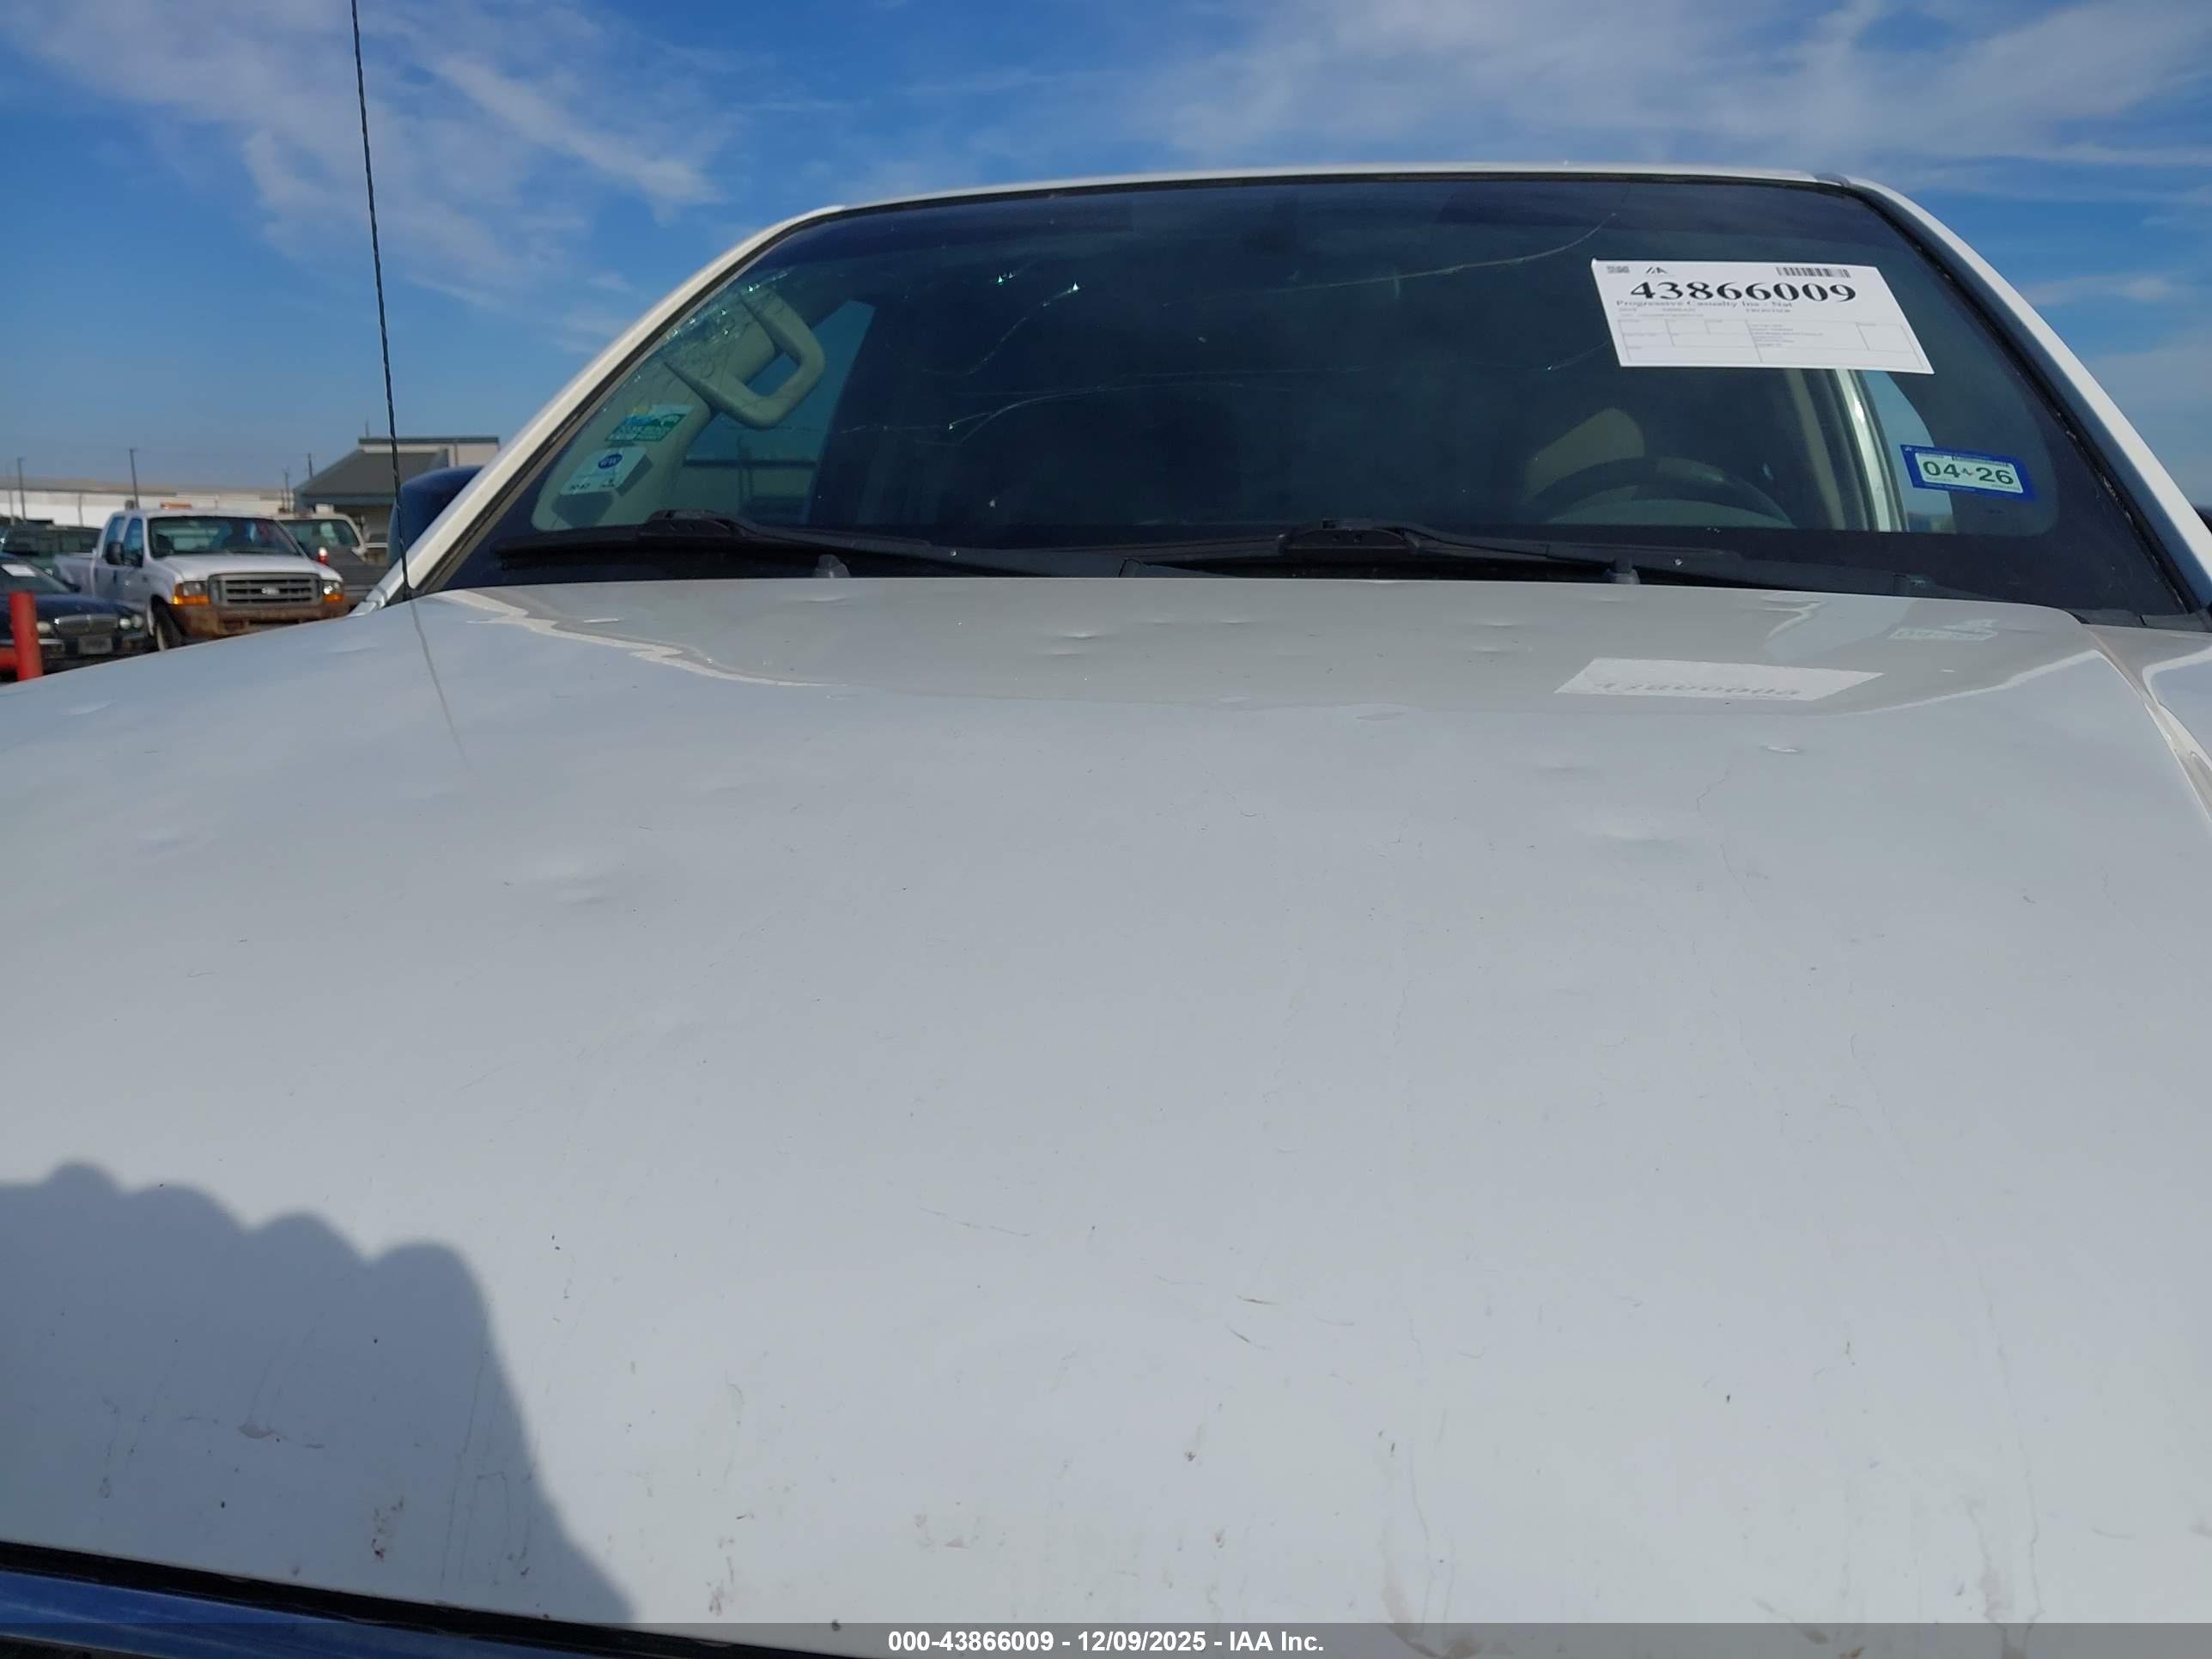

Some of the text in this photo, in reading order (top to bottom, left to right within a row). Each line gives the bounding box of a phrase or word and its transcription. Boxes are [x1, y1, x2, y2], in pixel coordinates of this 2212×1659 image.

[1630, 282, 1856, 301] 43866009
[1923, 461, 1960, 478] 04
[1975, 467, 2014, 484] 26
